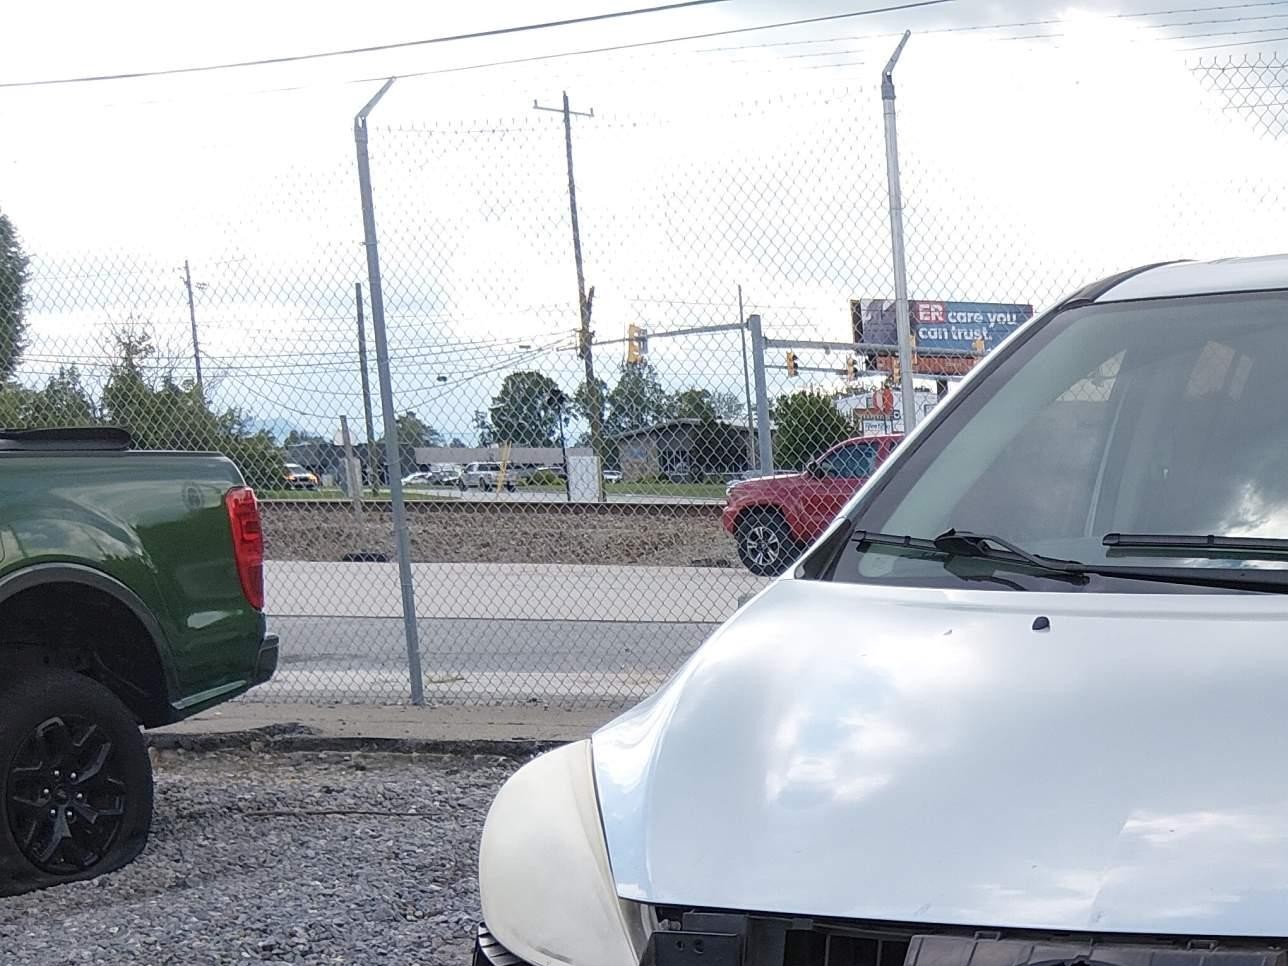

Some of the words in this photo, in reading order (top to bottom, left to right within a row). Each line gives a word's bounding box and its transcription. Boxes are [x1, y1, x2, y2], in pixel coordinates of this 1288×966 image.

[918, 303, 944, 320] ER
[947, 310, 984, 323] care
[986, 311, 1017, 328] you
[918, 327, 948, 340] can
